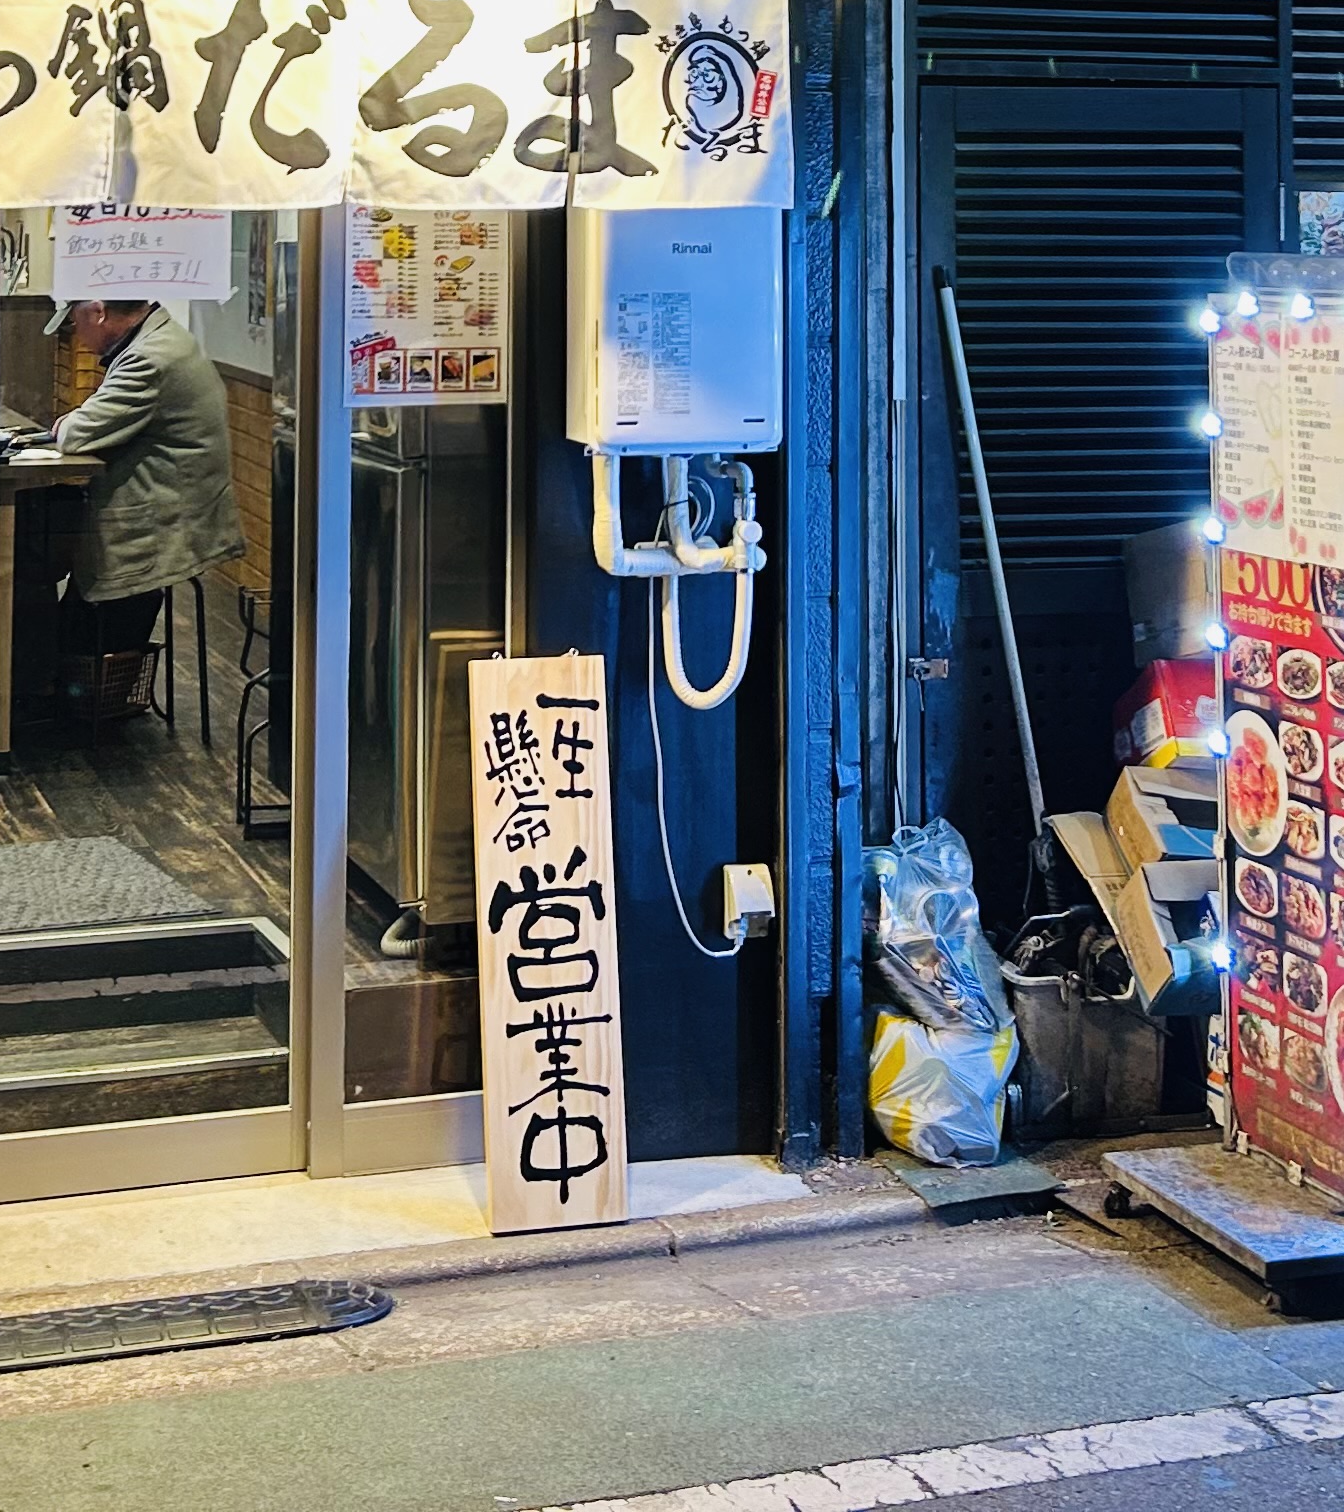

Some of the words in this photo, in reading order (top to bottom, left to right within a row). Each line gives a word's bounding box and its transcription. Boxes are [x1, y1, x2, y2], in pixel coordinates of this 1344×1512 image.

[661, 117, 769, 162] だるま
[671, 242, 713, 254] Rinnai
[484, 708, 551, 854] 懸命
[535, 692, 600, 800] 一生
[487, 845, 613, 1206] 営業中
